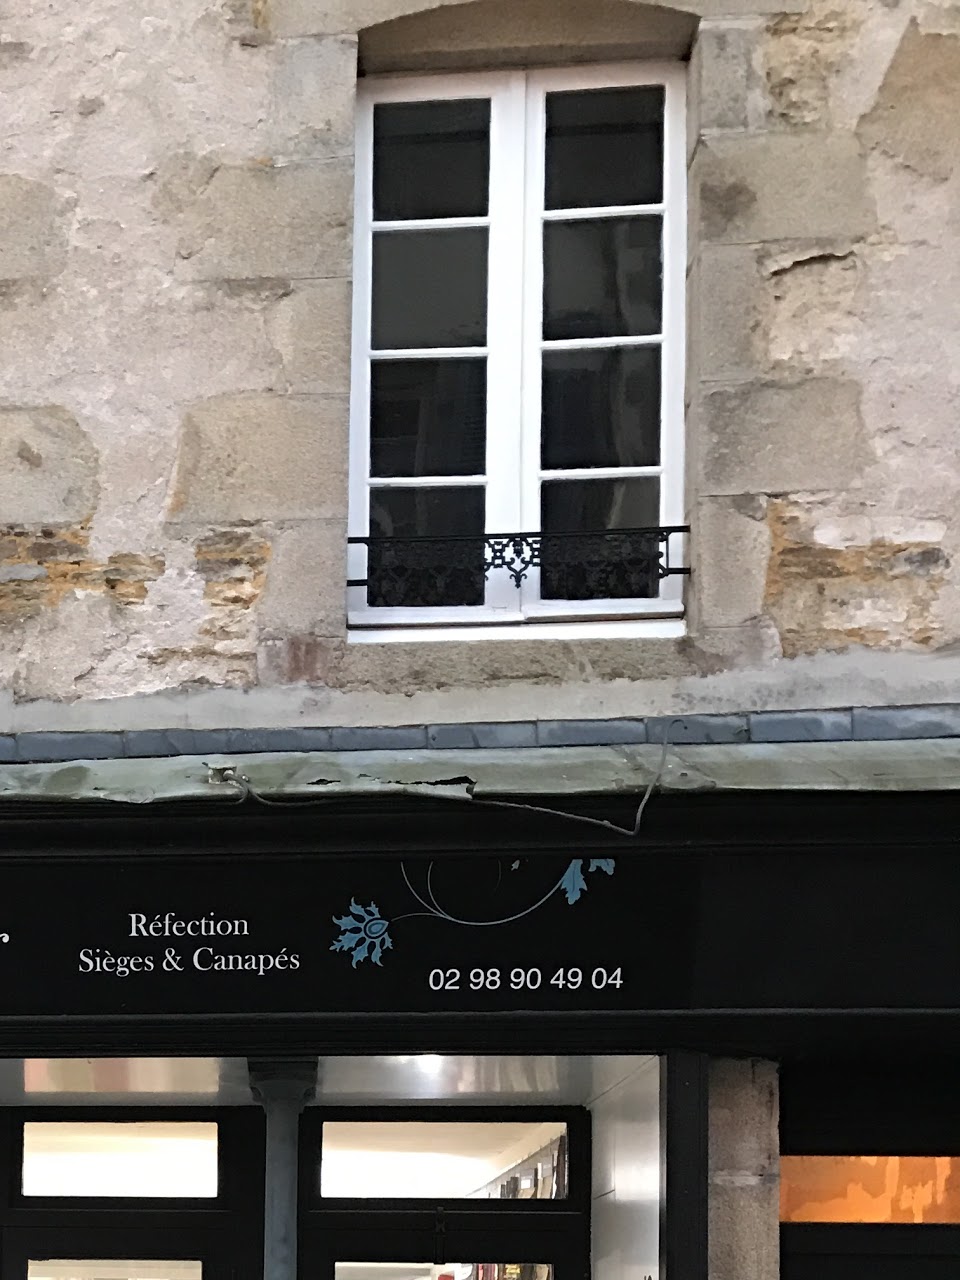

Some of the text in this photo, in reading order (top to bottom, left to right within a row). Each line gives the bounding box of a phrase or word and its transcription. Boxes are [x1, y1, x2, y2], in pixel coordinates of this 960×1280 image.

[128, 911, 250, 937] Réfection
[78, 946, 300, 977] Sièges & Canapés
[428, 967, 624, 991] 02 98 90 49 04
